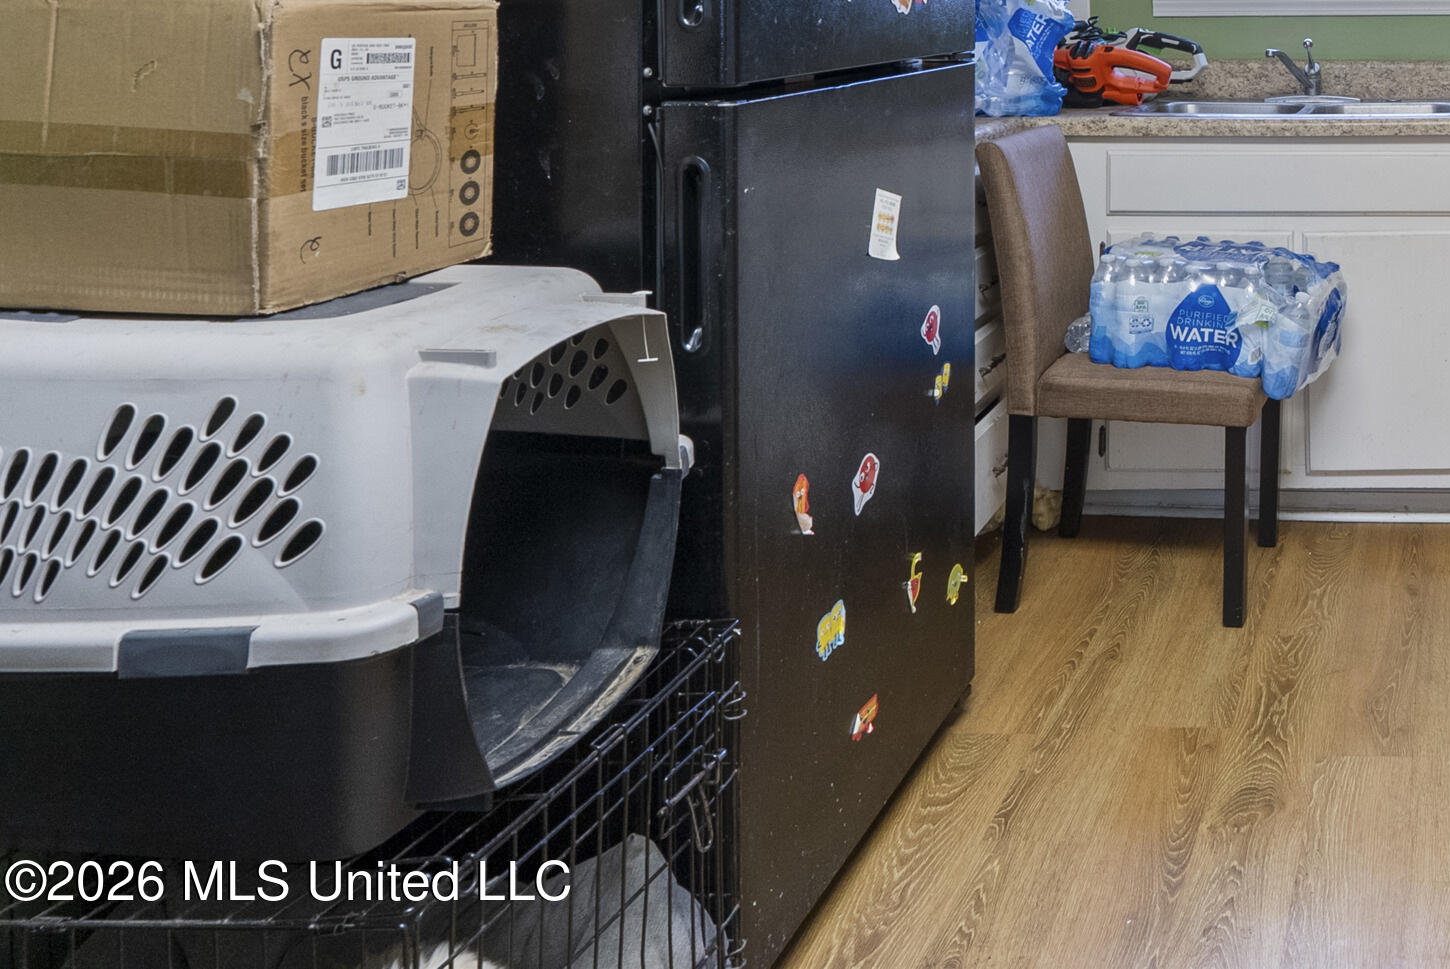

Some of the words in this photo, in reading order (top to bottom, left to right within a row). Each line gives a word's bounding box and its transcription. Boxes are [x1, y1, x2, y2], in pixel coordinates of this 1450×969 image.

[1025, 13, 1048, 49] ATER
[331, 49, 342, 69] G
[301, 96, 309, 120] black
[300, 147, 308, 177] bucket
[1177, 317, 1224, 328] DRINKIN
[1179, 309, 1228, 324] PURIFIED
[1170, 323, 1239, 348] WATER
